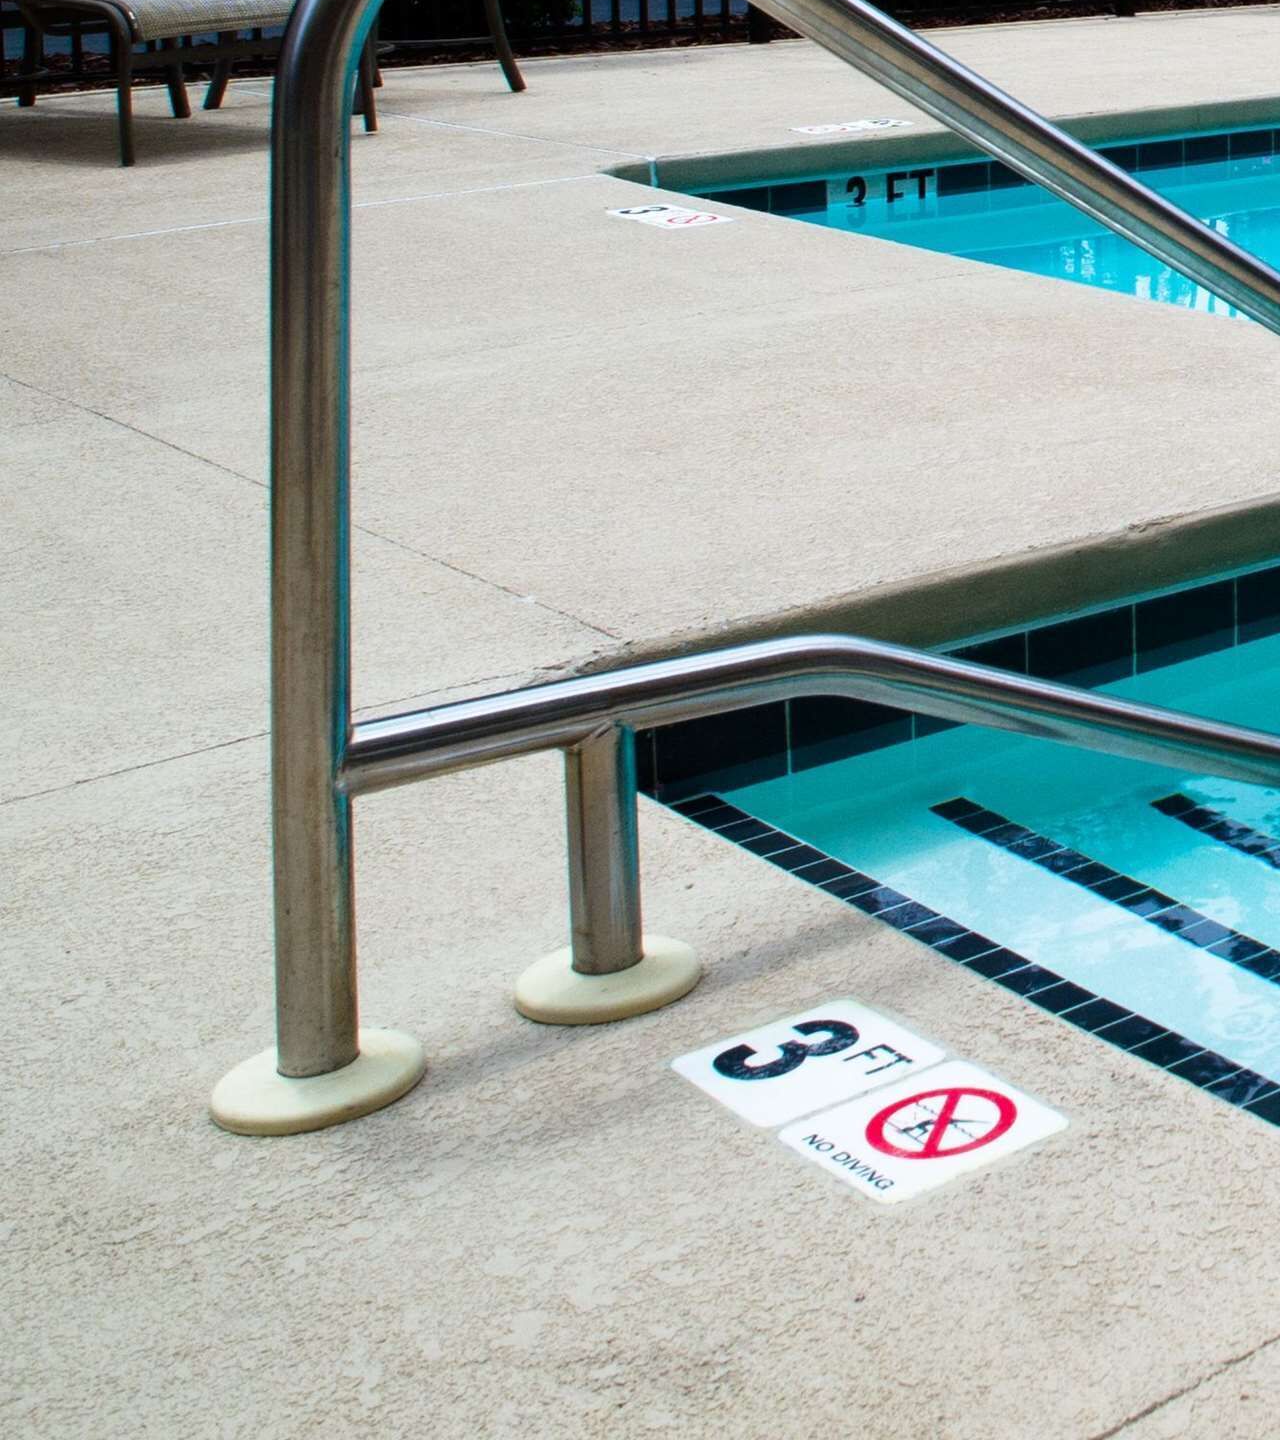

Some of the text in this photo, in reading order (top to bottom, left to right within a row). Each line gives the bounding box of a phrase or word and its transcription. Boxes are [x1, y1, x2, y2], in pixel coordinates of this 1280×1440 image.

[886, 169, 935, 203] FT
[713, 1020, 913, 1081] 3 FT
[802, 1133, 895, 1190] NO DIVING
